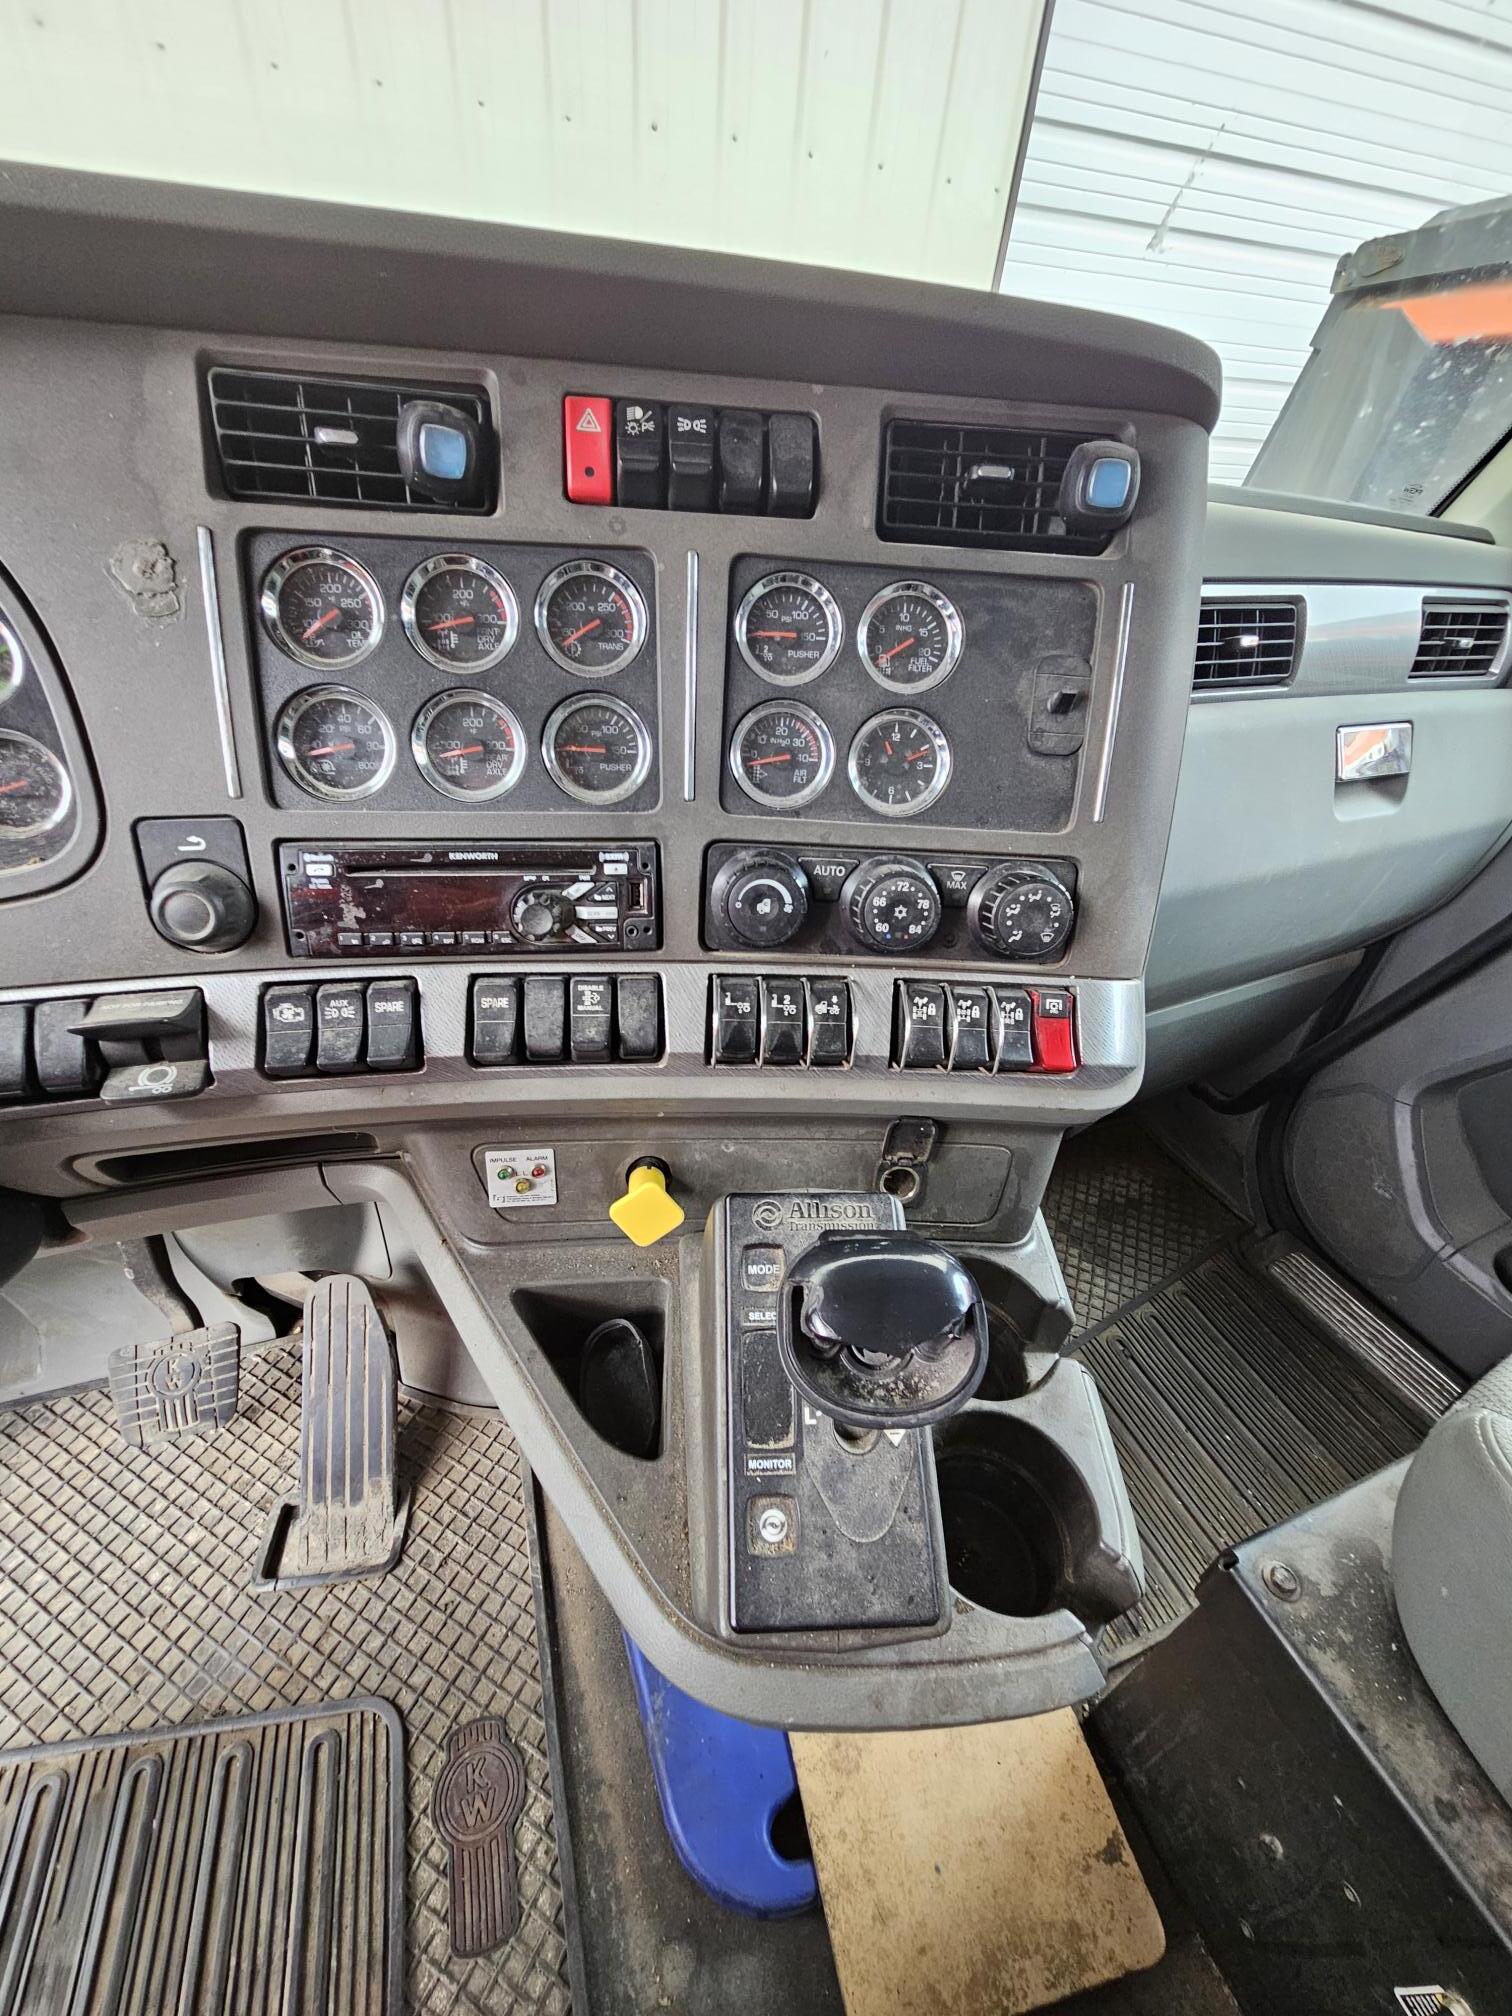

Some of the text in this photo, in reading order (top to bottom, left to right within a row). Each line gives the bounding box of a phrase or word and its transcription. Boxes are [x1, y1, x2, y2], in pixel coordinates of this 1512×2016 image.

[320, 584, 342, 593] 200
[452, 589, 474, 599] 200
[340, 598, 362, 608] 250
[566, 602, 585, 611] 200
[597, 603, 616, 612] 250
[766, 610, 779, 619] 50
[792, 611, 809, 620] 100
[899, 613, 910, 622] 10
[879, 626, 886, 634] 5
[919, 628, 929, 637] 15
[346, 639, 365, 648] TEM
[597, 642, 624, 651] TRANS
[787, 650, 820, 659] PUSHER
[910, 657, 928, 665] FUEL
[337, 714, 352, 723] 40
[462, 718, 483, 727] 200
[319, 724, 333, 733] 20
[357, 725, 372, 734] 60
[601, 726, 619, 735] 100
[775, 726, 788, 736] 20
[757, 735, 767, 744] 10
[891, 733, 901, 742] 12
[792, 738, 805, 748] 30
[613, 746, 627, 755] 50
[750, 749, 758, 758] 0
[864, 758, 871, 767] 9
[916, 761, 924, 770] 3
[599, 763, 632, 772] PUSHER
[793, 776, 807, 784] FILT
[887, 786, 895, 795] 6
[449, 852, 498, 860] KENWORTH
[813, 865, 846, 877] AUTO
[897, 881, 910, 892] 72
[946, 880, 968, 889] MAX
[872, 896, 887, 906] 66
[917, 898, 930, 910] 78
[875, 922, 890, 933] 60
[908, 924, 922, 935] 84
[329, 999, 349, 1007] AUX
[374, 1000, 405, 1013] SPARE
[480, 997, 510, 1009] SPARE
[489, 1156, 518, 1164] IMPULSE
[788, 1199, 875, 1220] Allison
[789, 1221, 879, 1231] Transmission
[747, 1264, 781, 1275] MODE
[748, 1311, 777, 1321] SELEC
[748, 1458, 792, 1470] MONITOR
